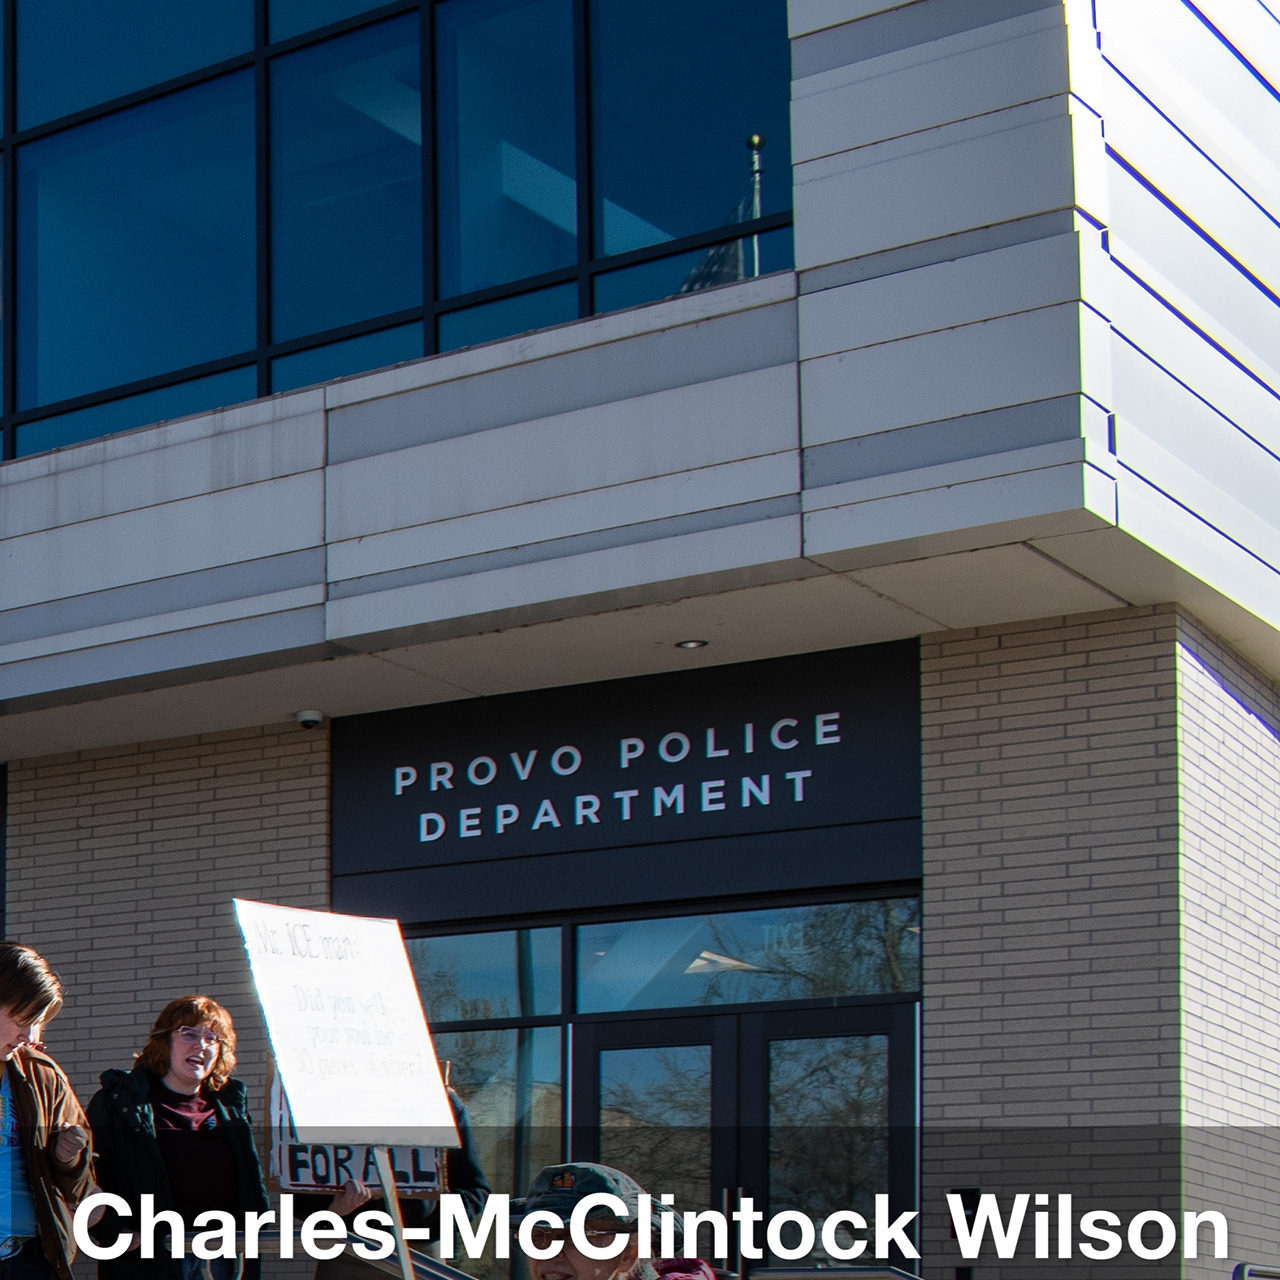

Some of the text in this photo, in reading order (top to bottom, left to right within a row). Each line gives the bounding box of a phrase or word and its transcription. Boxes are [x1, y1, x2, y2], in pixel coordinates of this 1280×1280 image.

[394, 711, 843, 796] PROVO POLICE
[418, 769, 815, 843] DEPARTMENT
[285, 921, 320, 959] ICE
[292, 983, 326, 1013] Did
[327, 993, 356, 1020] you
[288, 1143, 356, 1186] FOR
